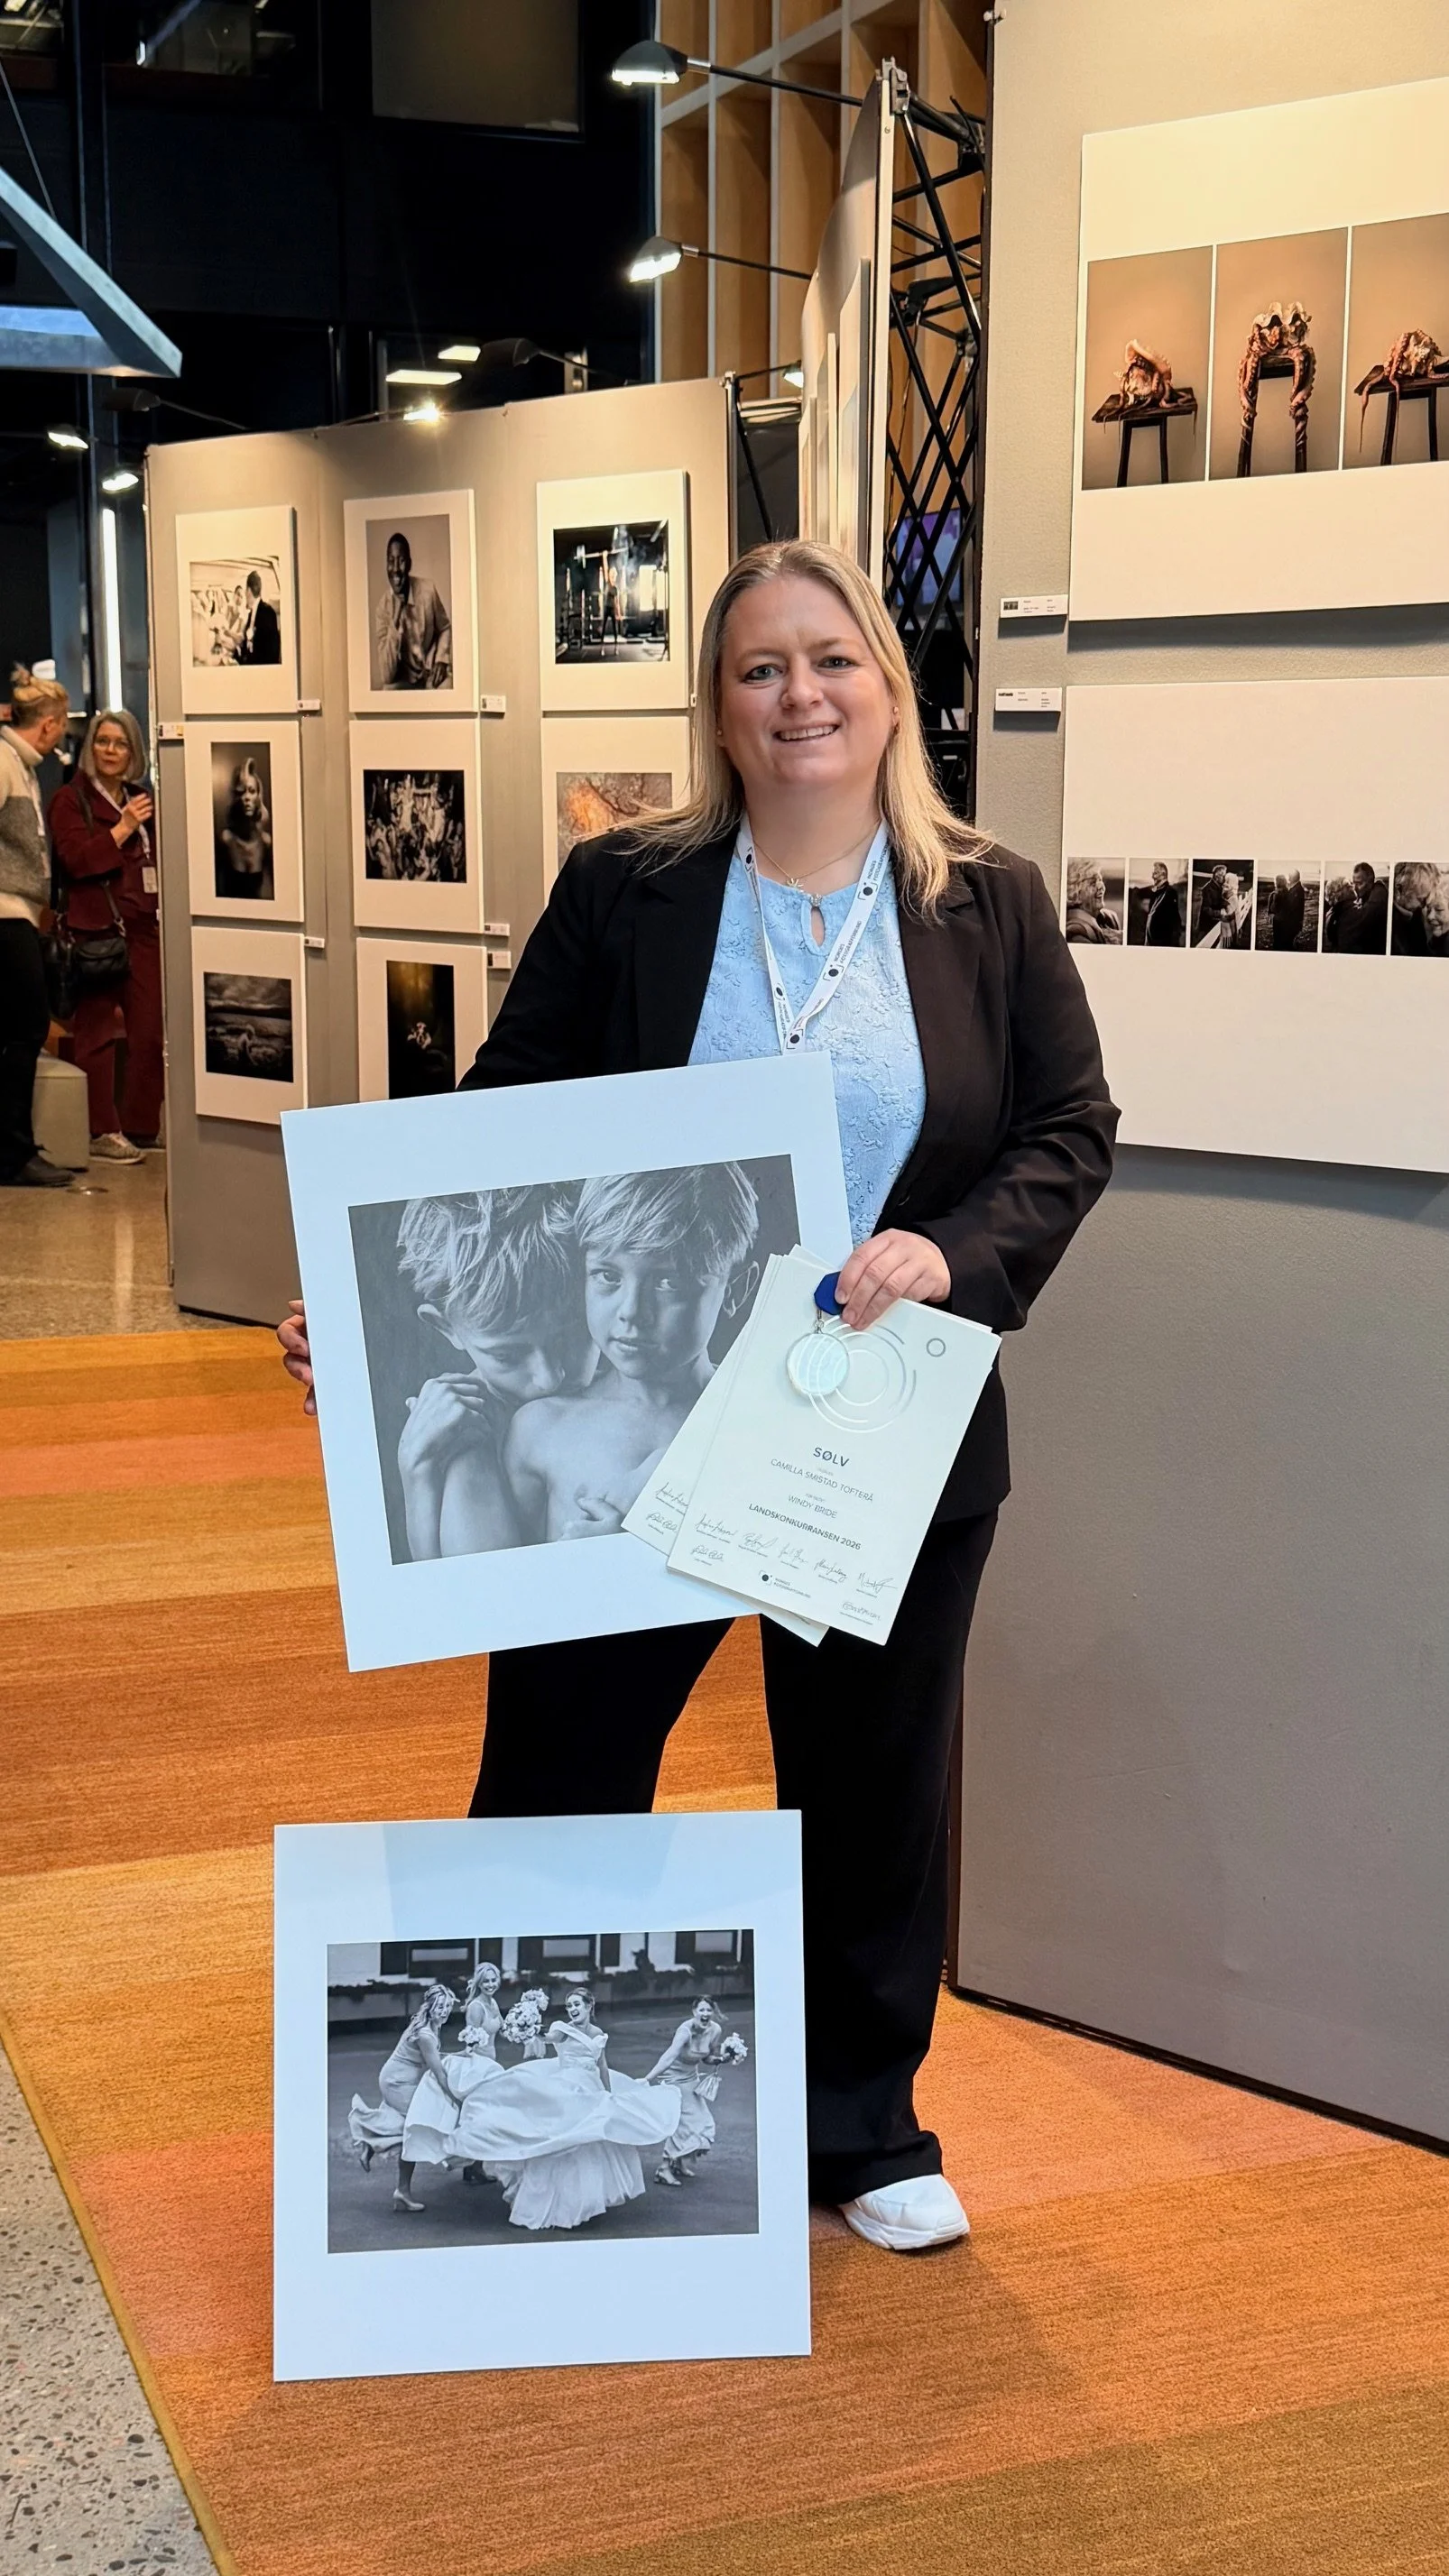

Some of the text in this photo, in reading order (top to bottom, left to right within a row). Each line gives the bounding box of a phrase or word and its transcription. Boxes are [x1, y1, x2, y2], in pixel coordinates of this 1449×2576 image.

[813, 1447, 850, 1467] SØLV
[771, 1458, 803, 1476] CAMILLA
[805, 1471, 838, 1488] SMISTAD
[840, 1484, 873, 1503] TOFTERÅ
[788, 1494, 814, 1509] WINDY
[814, 1504, 838, 1519] BRIDE
[748, 1503, 840, 1542] LANDSKONKURRANSEN
[840, 1537, 862, 1550] 2026
